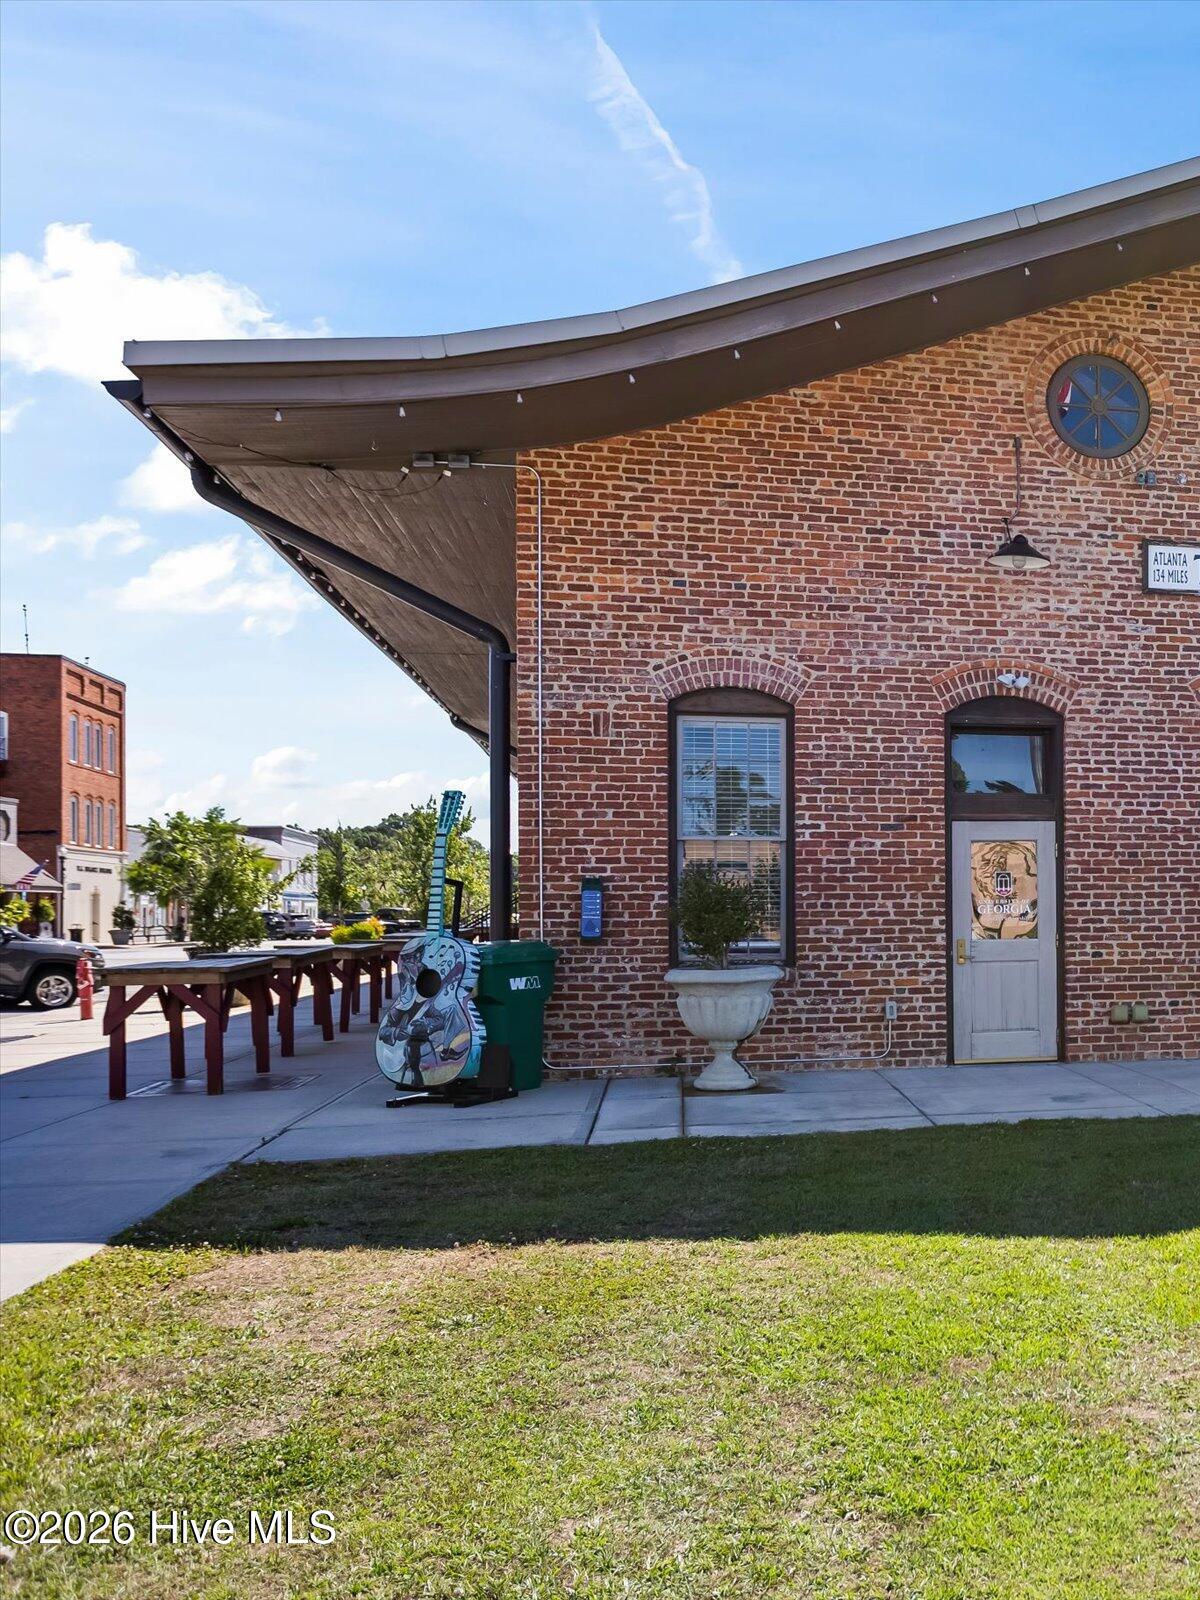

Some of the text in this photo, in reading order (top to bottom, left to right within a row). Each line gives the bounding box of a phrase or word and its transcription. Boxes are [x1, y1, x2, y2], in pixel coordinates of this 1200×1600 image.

[1153, 552, 1188, 567] ATLANTA
[1153, 569, 1189, 584] 134 MILES
[977, 904, 1031, 914] GEORGIA
[510, 976, 540, 990] WM
